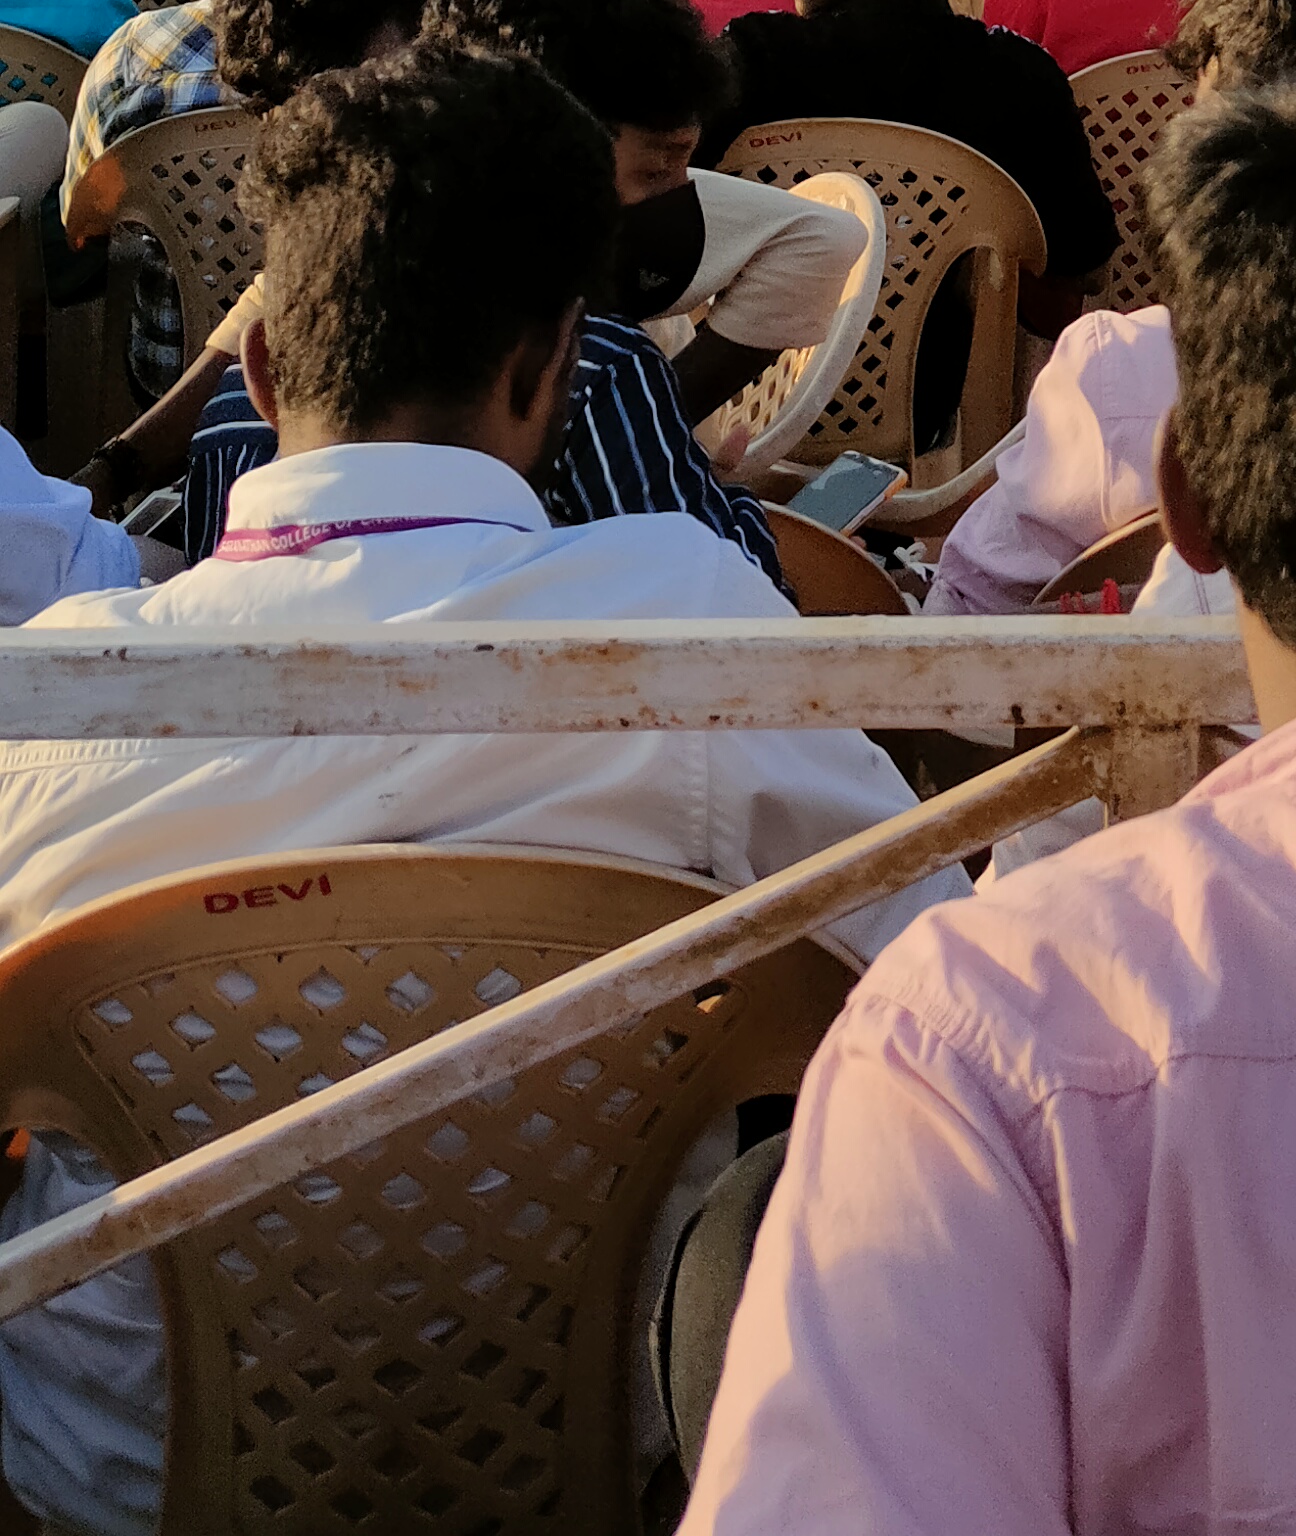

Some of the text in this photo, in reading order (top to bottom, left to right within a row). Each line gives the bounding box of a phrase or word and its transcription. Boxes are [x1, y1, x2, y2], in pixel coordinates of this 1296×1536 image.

[749, 130, 802, 148] DEVI
[270, 522, 331, 551] COLLEGE
[203, 873, 332, 915] DEVI
